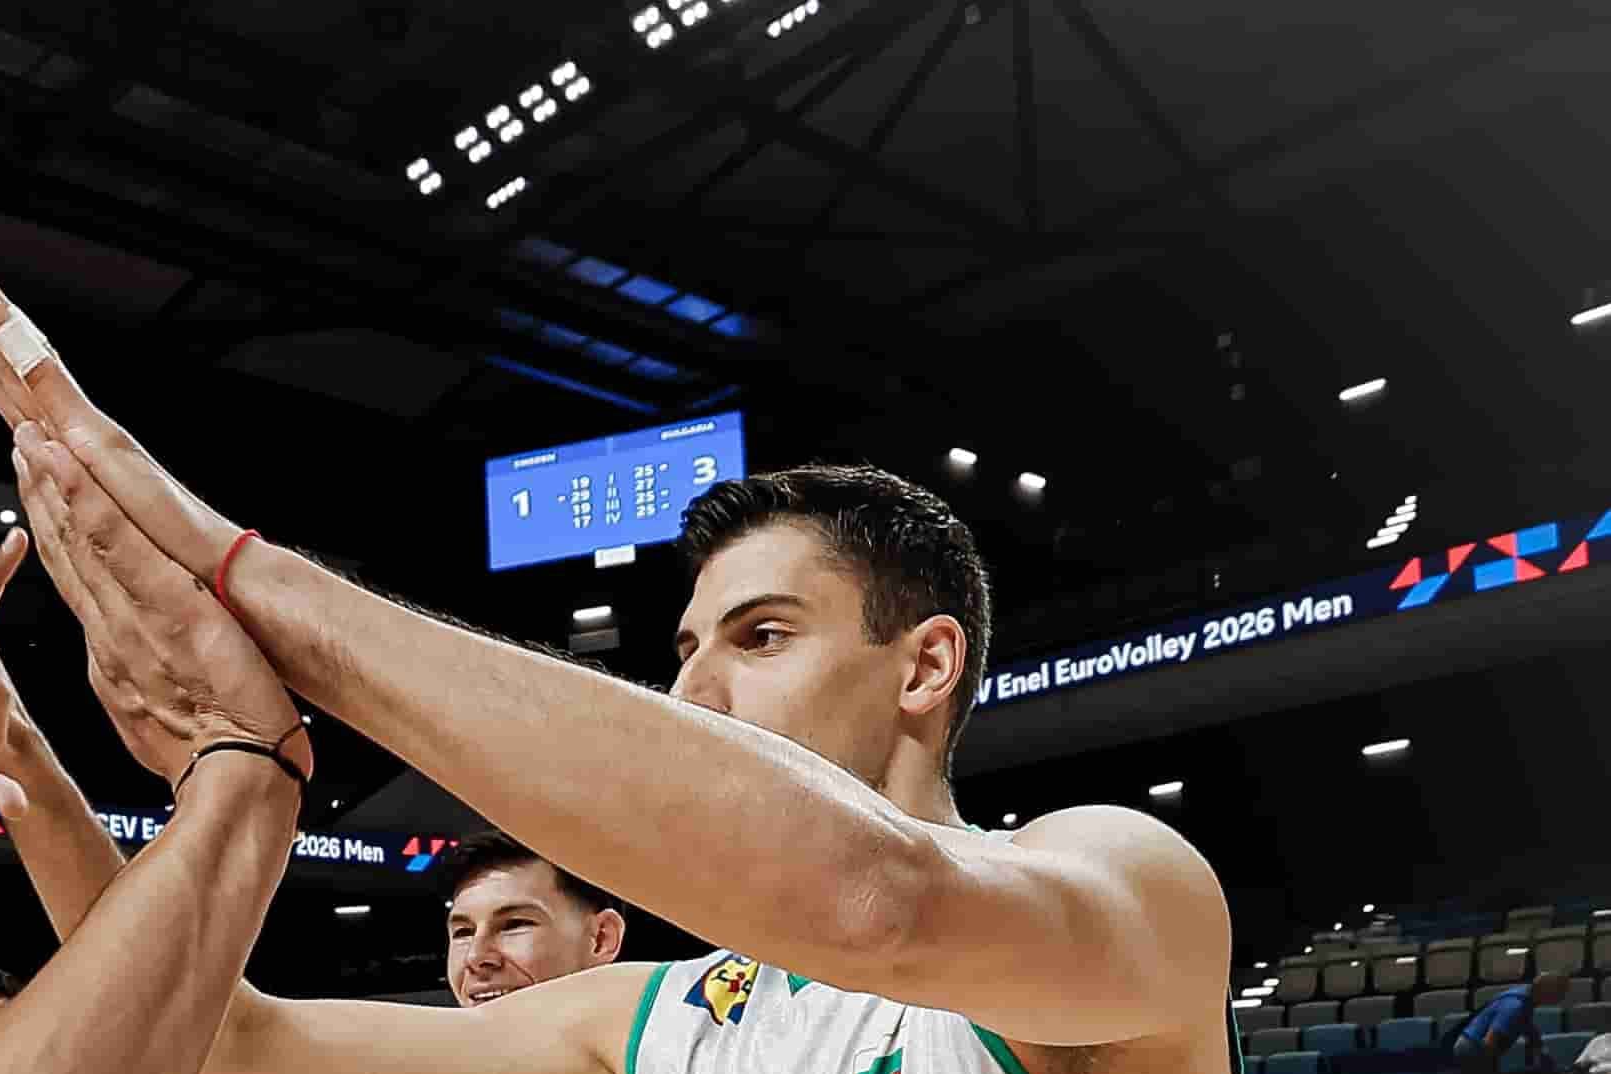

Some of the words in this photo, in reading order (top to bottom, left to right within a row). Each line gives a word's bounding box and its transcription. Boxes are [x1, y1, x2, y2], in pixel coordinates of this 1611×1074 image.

[634, 464, 655, 478] 25
[692, 456, 718, 485] 3
[511, 488, 531, 520] 1
[997, 662, 1050, 700] Enel
[1054, 633, 1196, 685] EuroVolley
[1202, 607, 1277, 649] 2026
[1282, 594, 1353, 630] Men
[296, 832, 340, 858] 2026
[344, 839, 385, 863] Men
